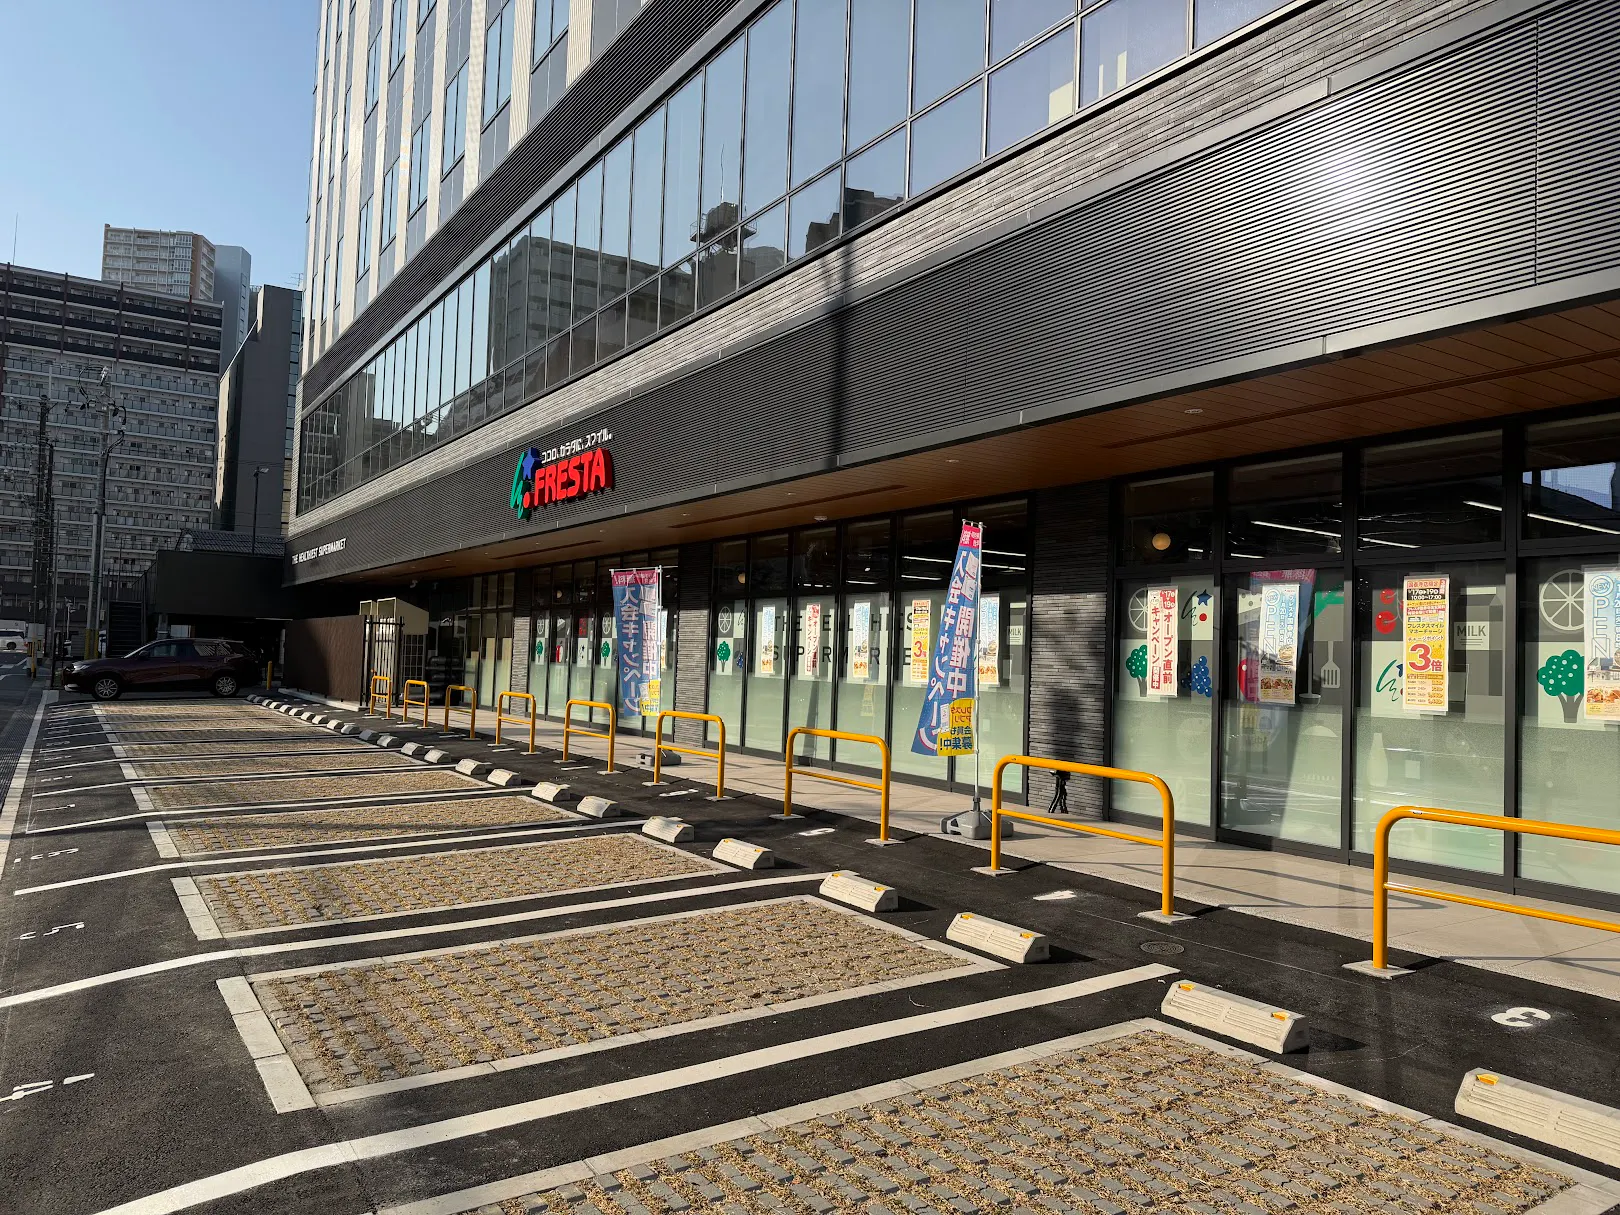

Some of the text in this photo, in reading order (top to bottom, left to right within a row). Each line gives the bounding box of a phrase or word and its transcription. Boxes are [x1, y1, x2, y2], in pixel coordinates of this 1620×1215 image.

[534, 447, 607, 506] FRESTA
[318, 538, 347, 557] SUPERMARKET
[1008, 627, 1022, 636] MILK
[1151, 605, 1161, 665] キャンペーン
[1163, 611, 1174, 685] オープン直前
[1457, 624, 1487, 638] MILK
